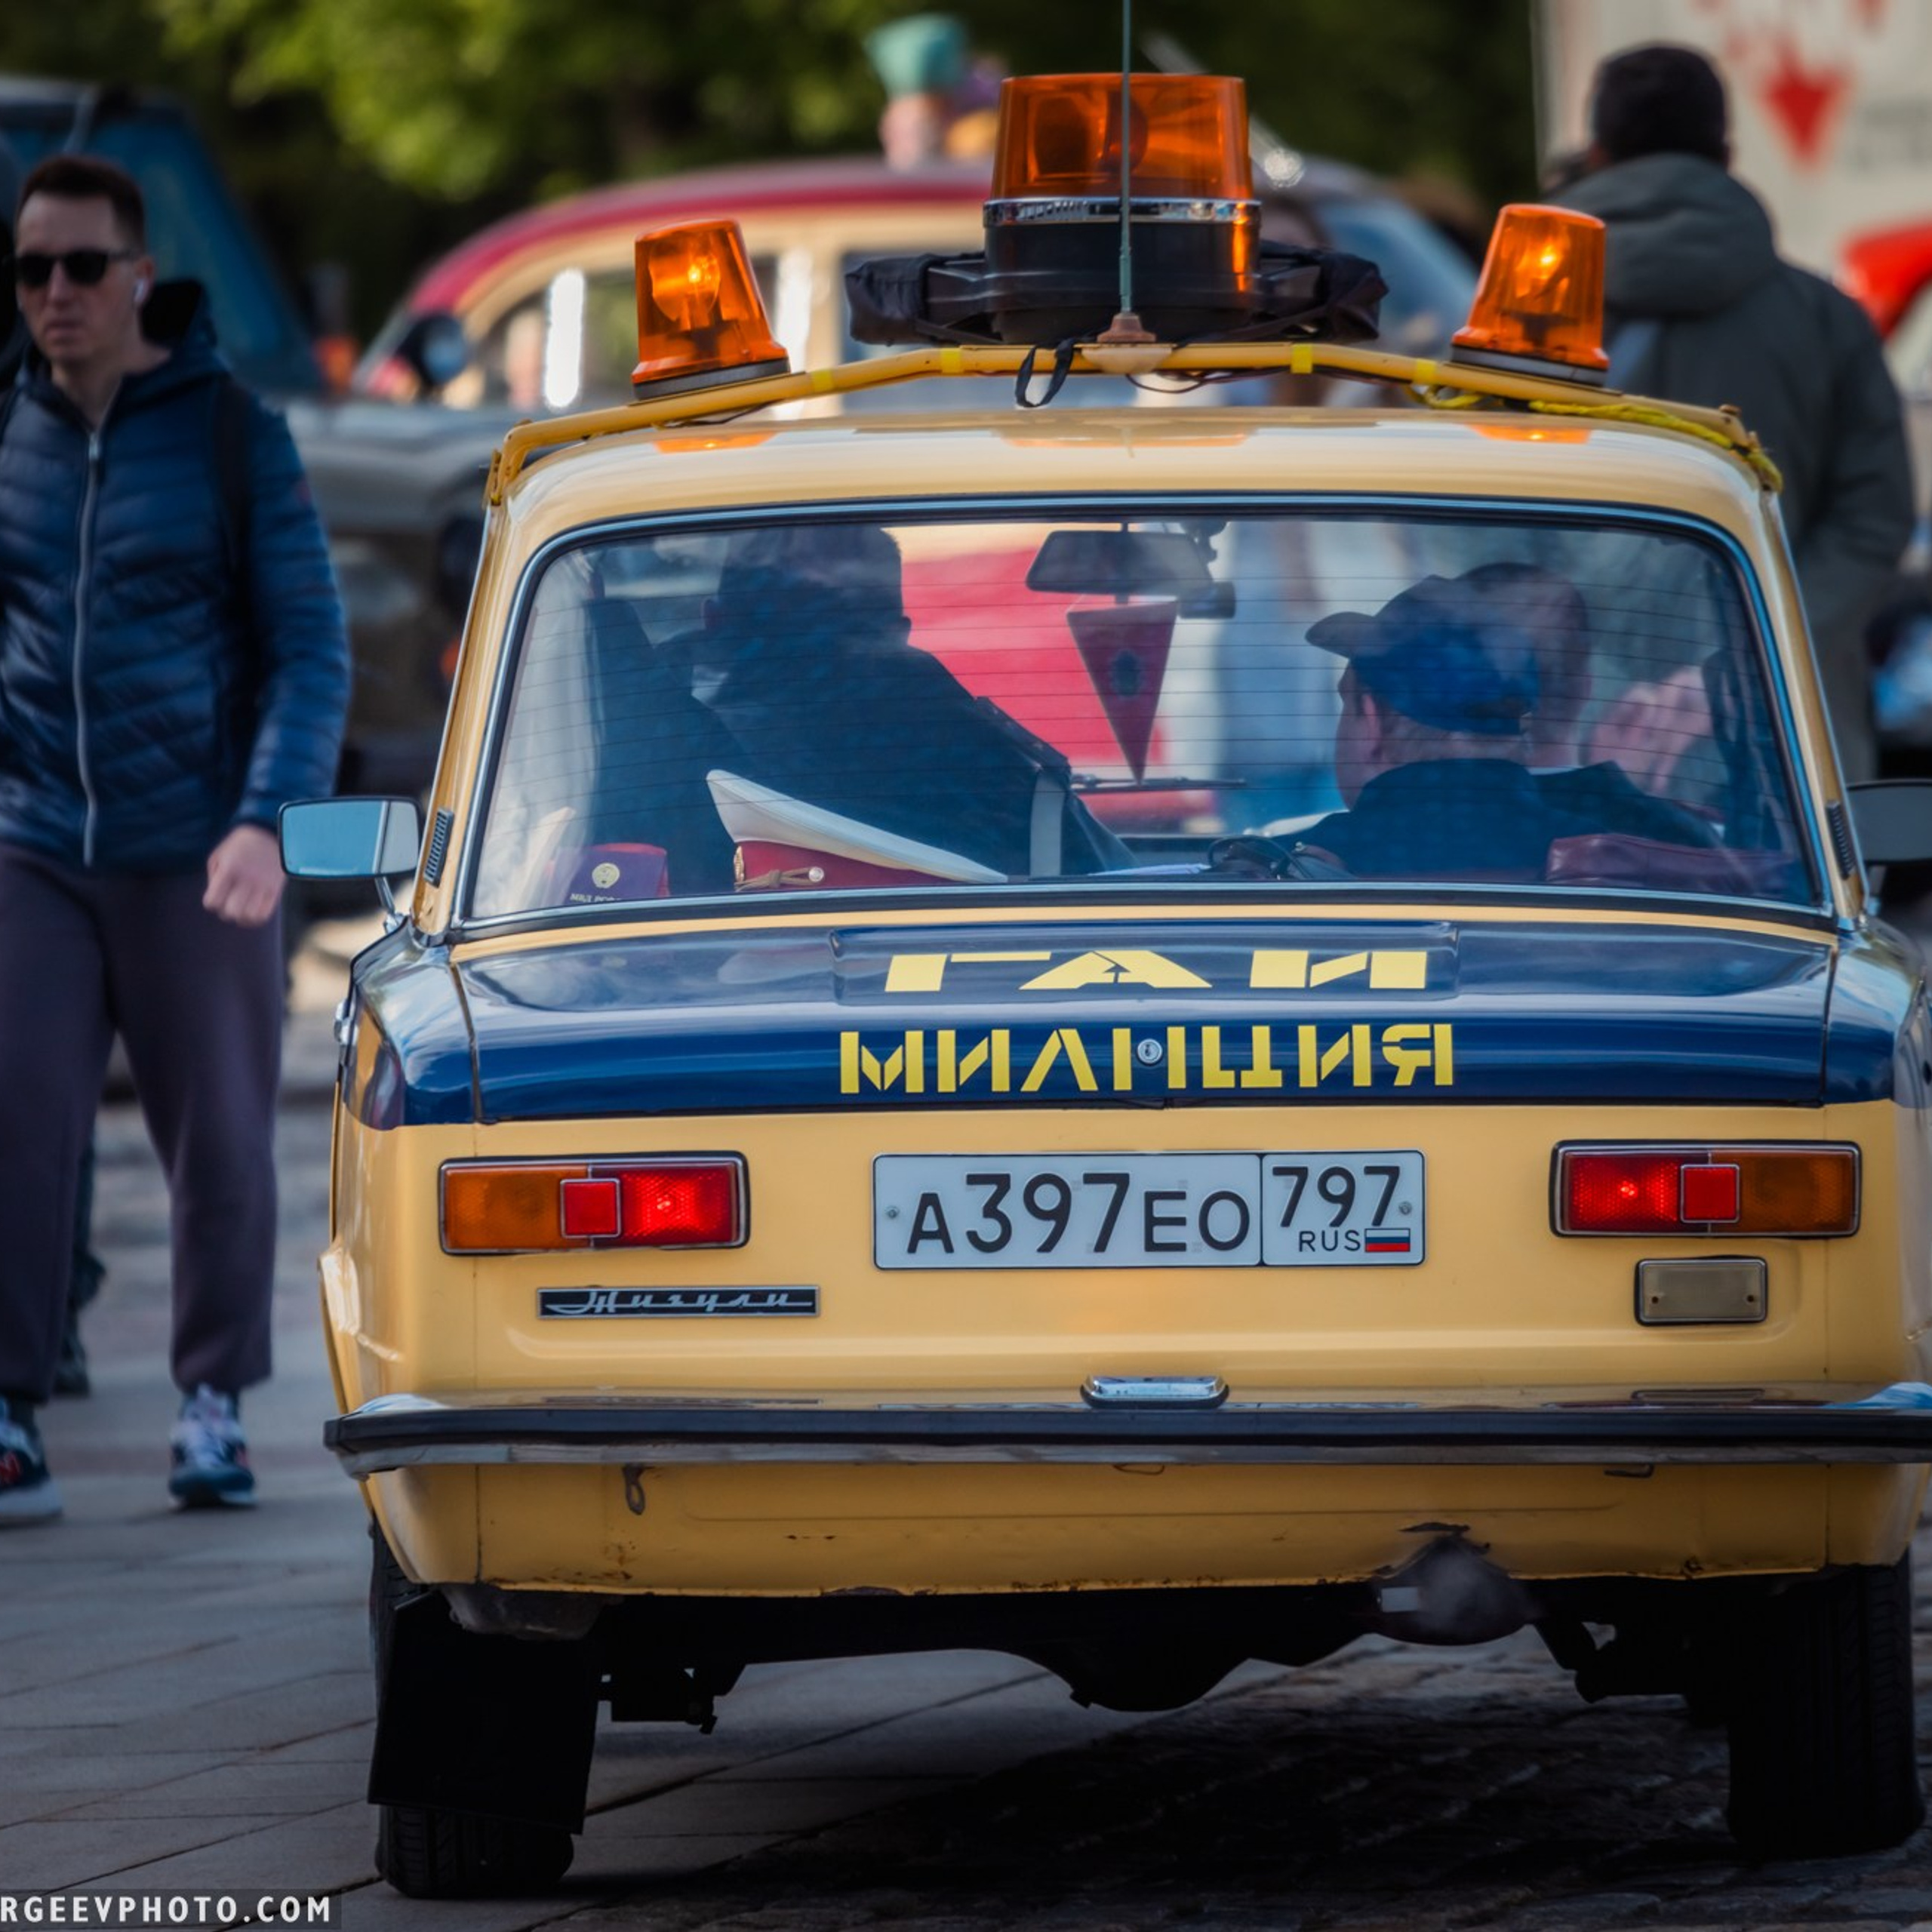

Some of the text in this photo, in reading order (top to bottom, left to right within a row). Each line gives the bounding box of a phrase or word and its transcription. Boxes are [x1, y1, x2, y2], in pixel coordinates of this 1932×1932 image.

[884, 950, 1427, 992] ГАИ
[841, 1023, 1453, 1094] МИЛИЦИЯ
[1272, 1166, 1401, 1228] 797
[1299, 1229, 1361, 1253] RUS
[545, 1290, 812, 1314] Жигули
